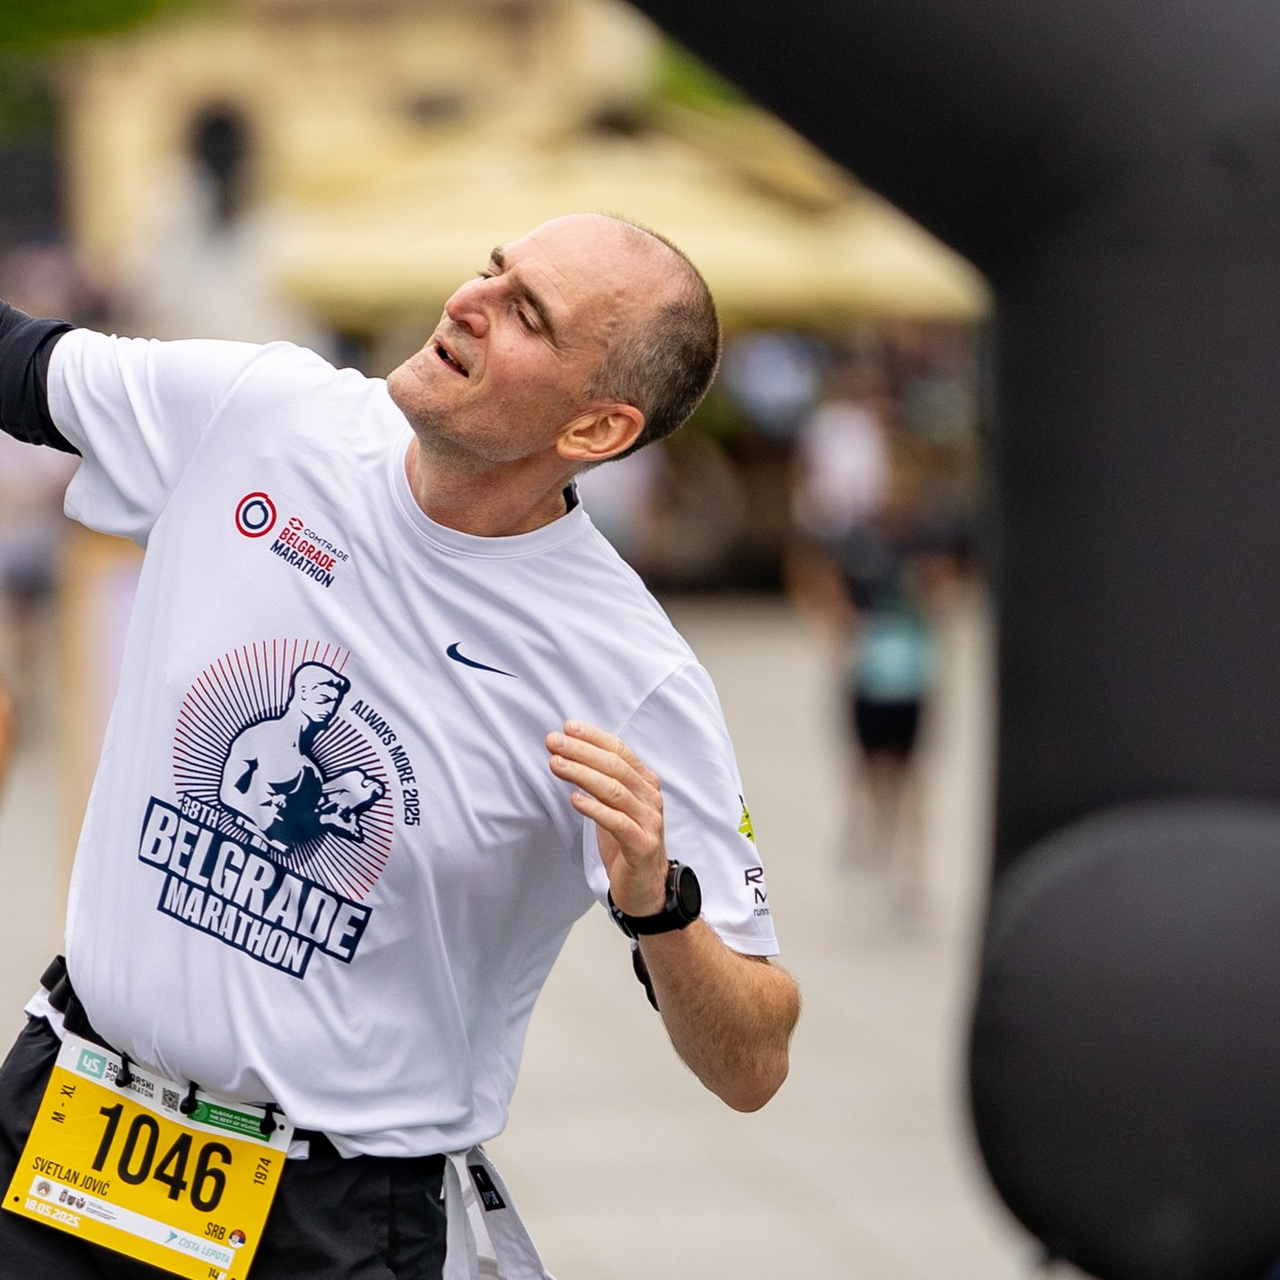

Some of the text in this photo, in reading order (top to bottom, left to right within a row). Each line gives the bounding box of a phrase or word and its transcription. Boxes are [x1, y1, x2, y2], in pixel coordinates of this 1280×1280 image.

[270, 539, 335, 588] MARATHON
[278, 527, 336, 572] BELGRADE
[303, 528, 349, 562] COMTRADE
[350, 699, 420, 826] ALWAYS MORE 2025
[181, 796, 220, 829] 38TH
[139, 803, 370, 960] BELGRADE
[163, 876, 310, 974] MARATHON
[60, 1084, 76, 1098] XL
[107, 1061, 155, 1091] SOORSKI
[32, 1156, 111, 1197] SVETLAN JOVIĆ
[91, 1103, 233, 1213] 1046
[253, 1156, 272, 1187] 1974
[204, 1222, 227, 1240] SRB
